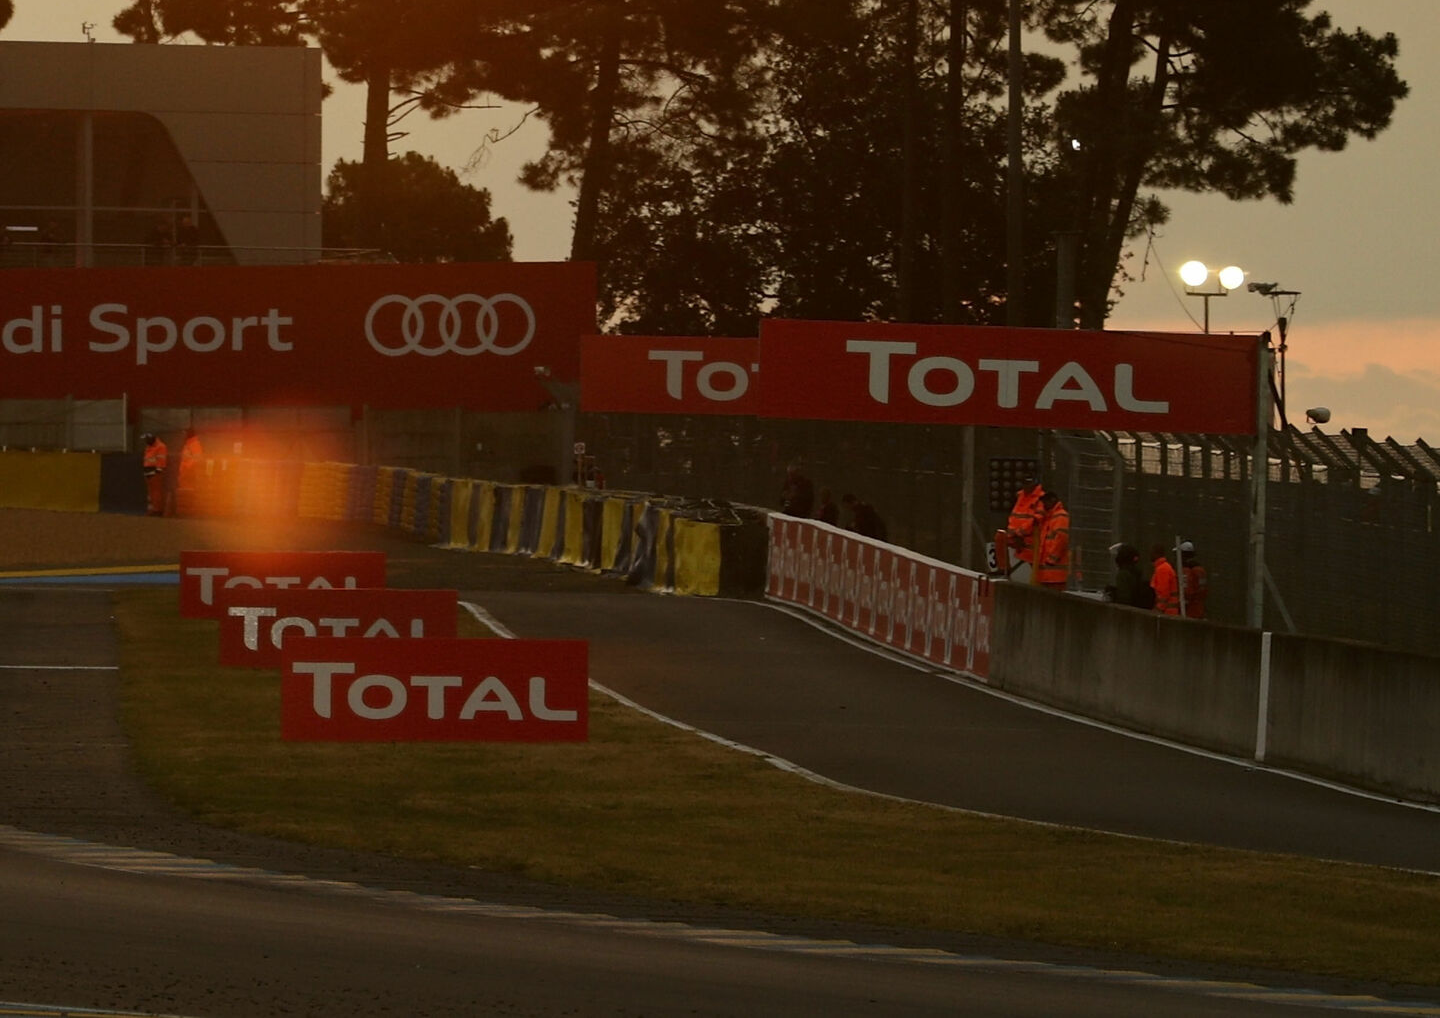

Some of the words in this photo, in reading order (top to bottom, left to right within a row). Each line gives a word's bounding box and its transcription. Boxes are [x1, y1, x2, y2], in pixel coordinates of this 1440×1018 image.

[89, 304, 293, 365] Sport
[648, 350, 760, 401] TO
[847, 340, 1169, 414] TOTAL
[293, 662, 578, 721] TOTAL
